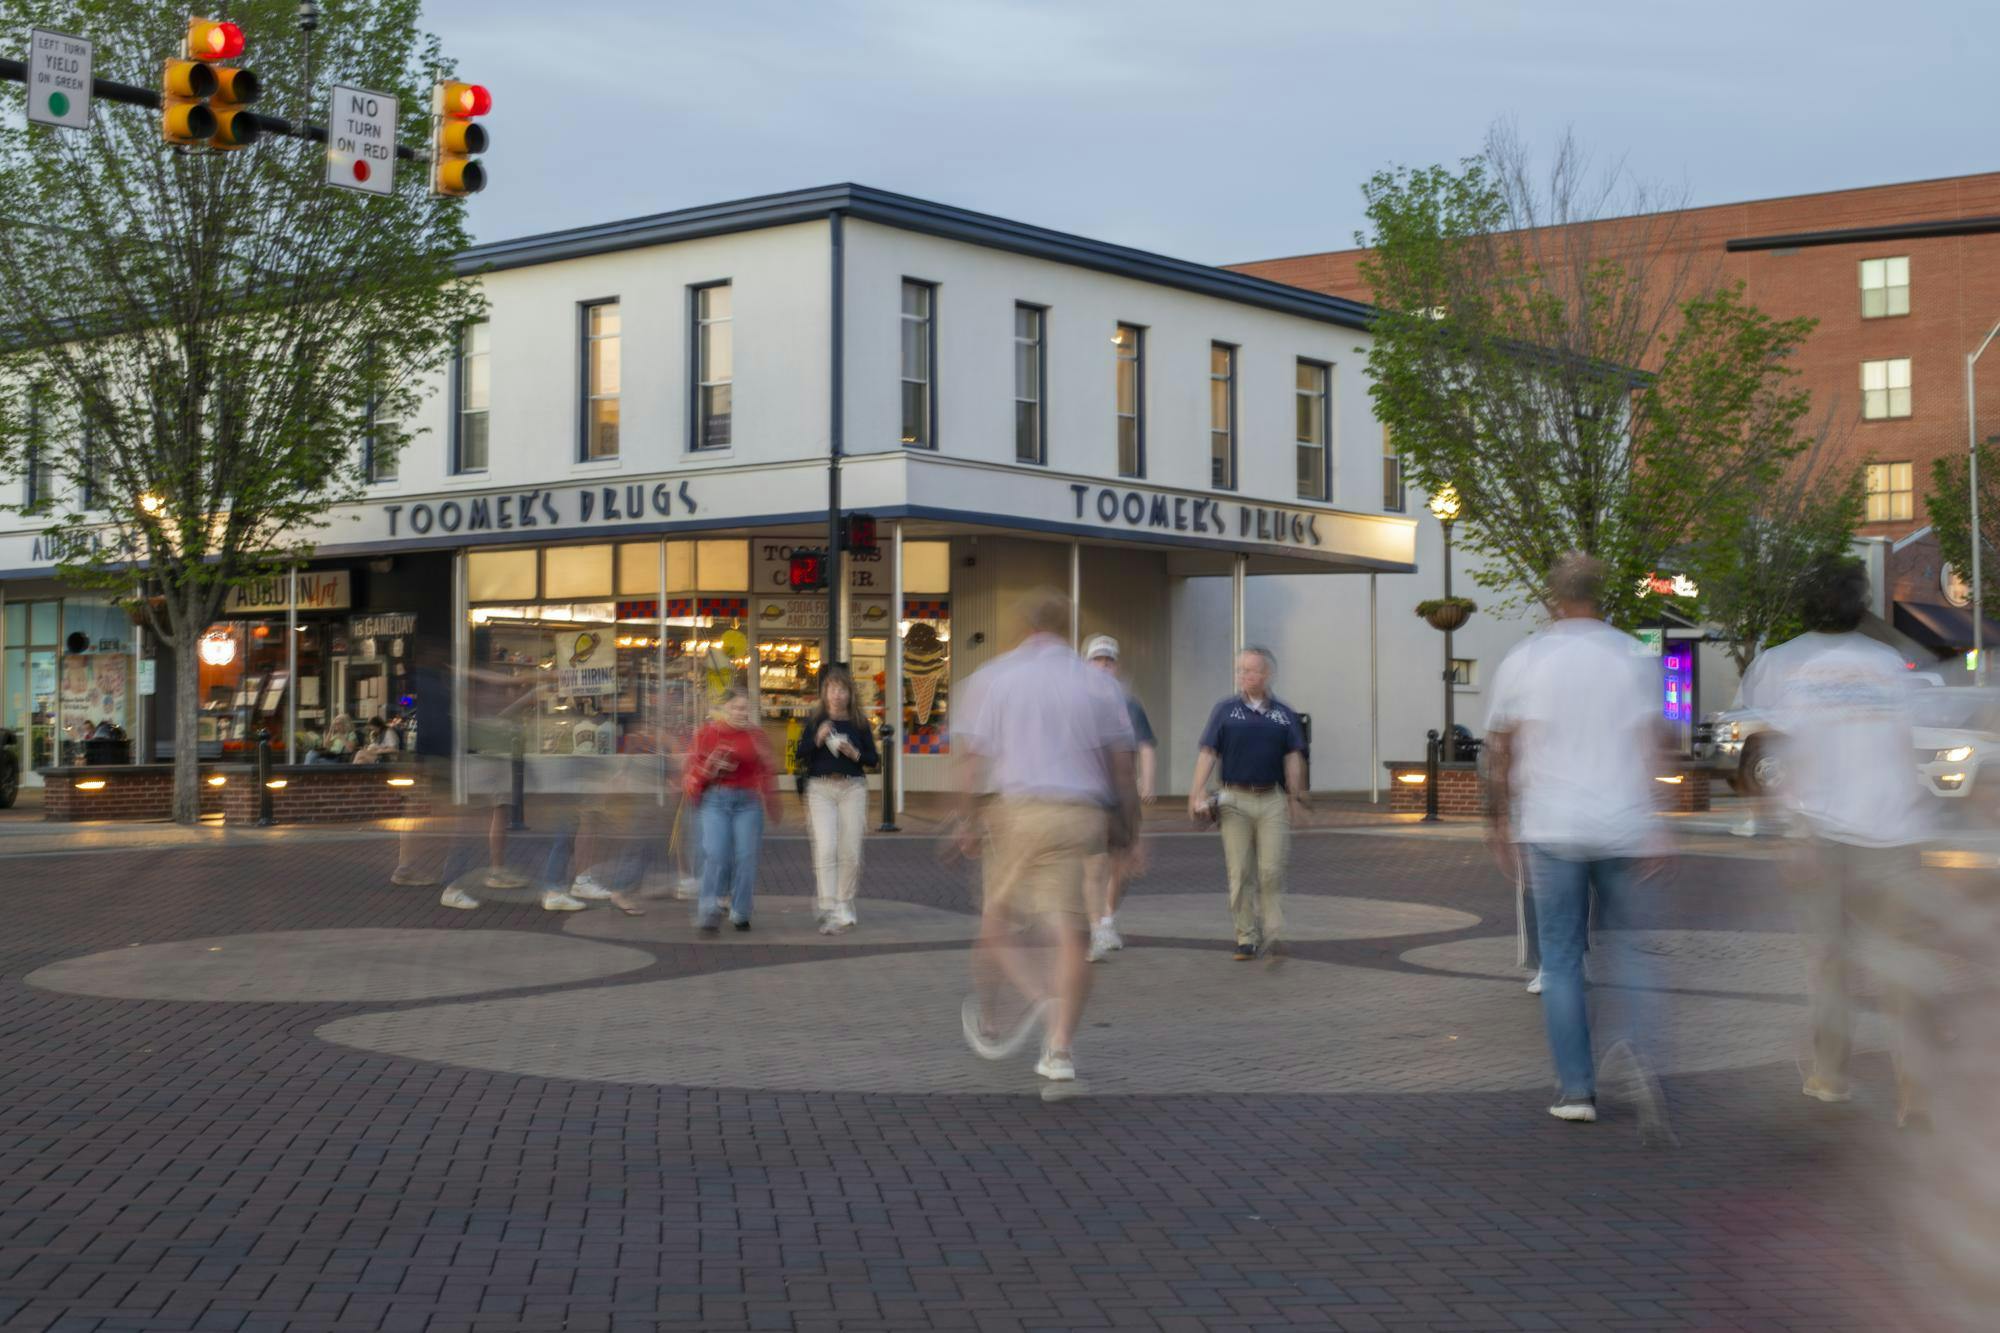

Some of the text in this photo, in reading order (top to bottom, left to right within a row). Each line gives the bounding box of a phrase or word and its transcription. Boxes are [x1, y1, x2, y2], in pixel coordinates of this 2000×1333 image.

[38, 38, 86, 56] LEFT TURN
[46, 54, 79, 74] YIELD
[38, 72, 83, 90] ON GREEN
[352, 96, 378, 117] NO
[347, 119, 382, 138] TURN
[337, 137, 389, 161] ON RED
[580, 480, 697, 523] DRUGS
[1240, 506, 1321, 546] DRUGS
[365, 615, 415, 636] GAMEDAY
[786, 614, 807, 627] AND
[581, 665, 615, 685] HIRING
